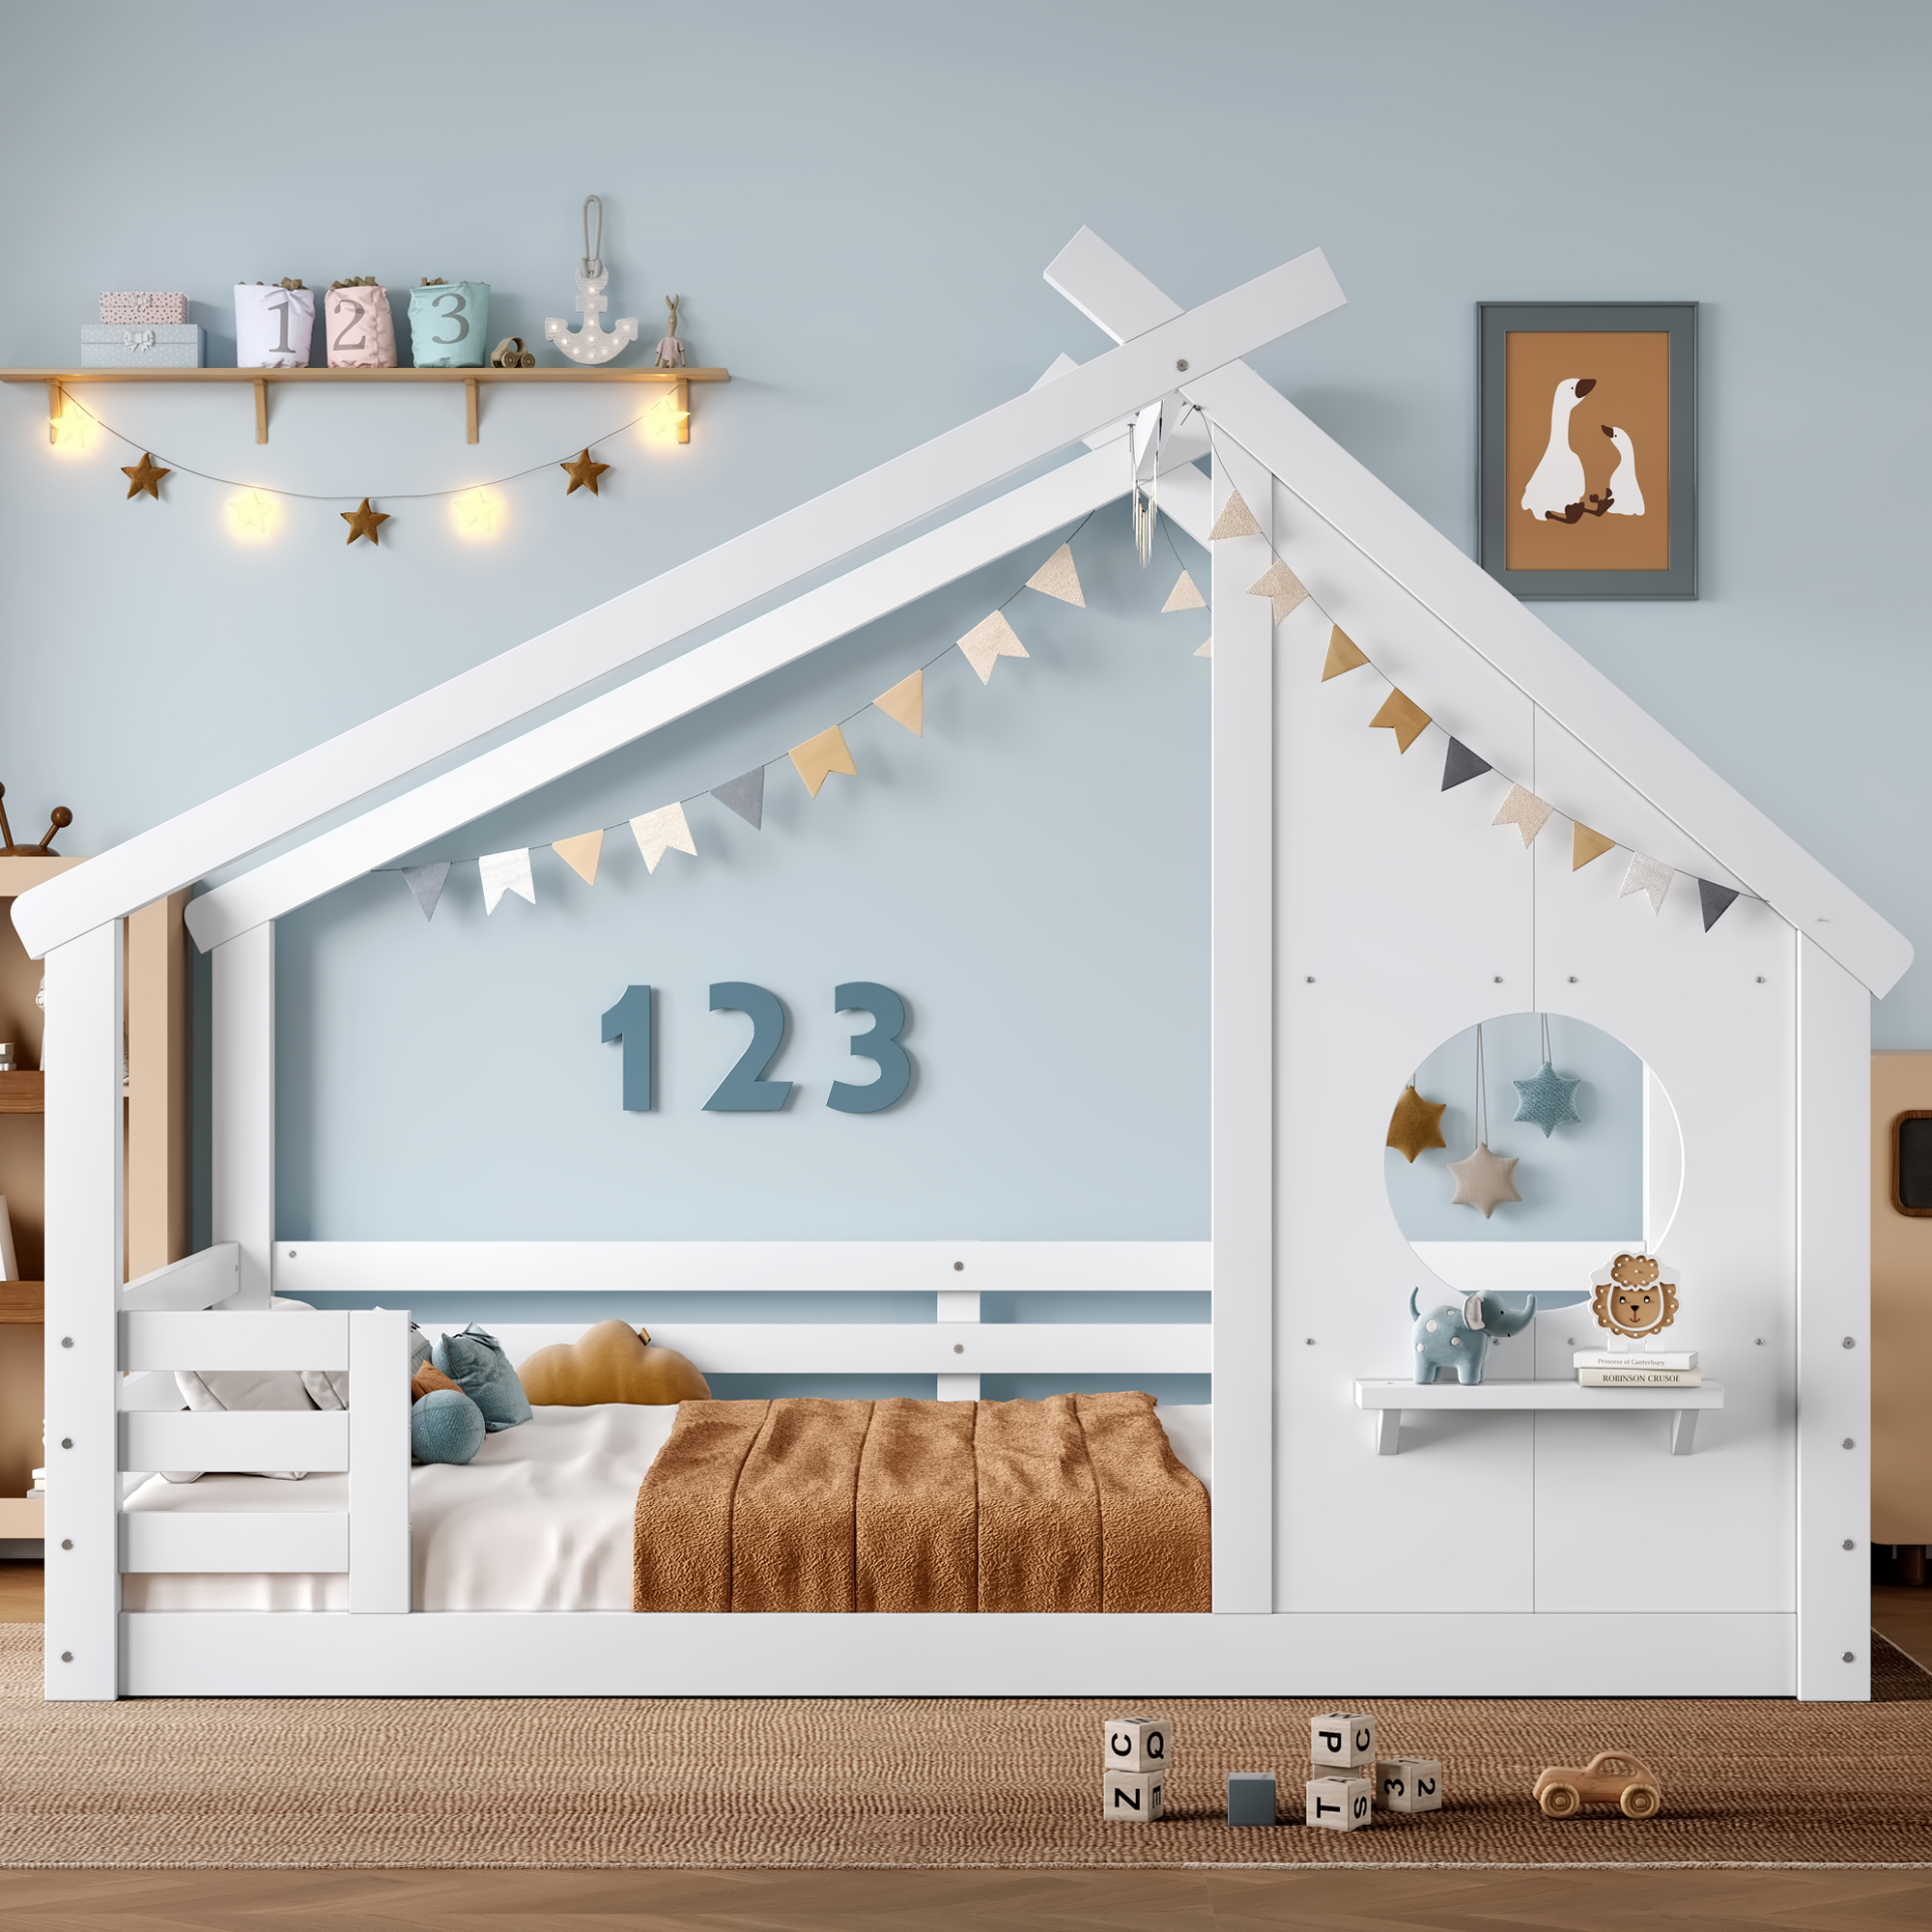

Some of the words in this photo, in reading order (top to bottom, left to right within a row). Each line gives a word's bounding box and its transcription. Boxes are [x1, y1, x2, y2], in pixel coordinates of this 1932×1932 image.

[268, 300, 296, 354] 1
[333, 299, 366, 351] 2
[431, 293, 469, 344] 3
[601, 984, 651, 1112] 1
[700, 981, 794, 1112] 2
[826, 981, 912, 1114] 3
[1631, 1358, 1665, 1367] Canterbury
[1111, 1733, 1132, 1756] C
[1147, 1731, 1164, 1759] Q
[1319, 1731, 1342, 1752] P
[1356, 1728, 1370, 1751] C
[1383, 1778, 1405, 1797] 3
[1317, 1797, 1341, 1818] T
[1353, 1796, 1367, 1819] S
